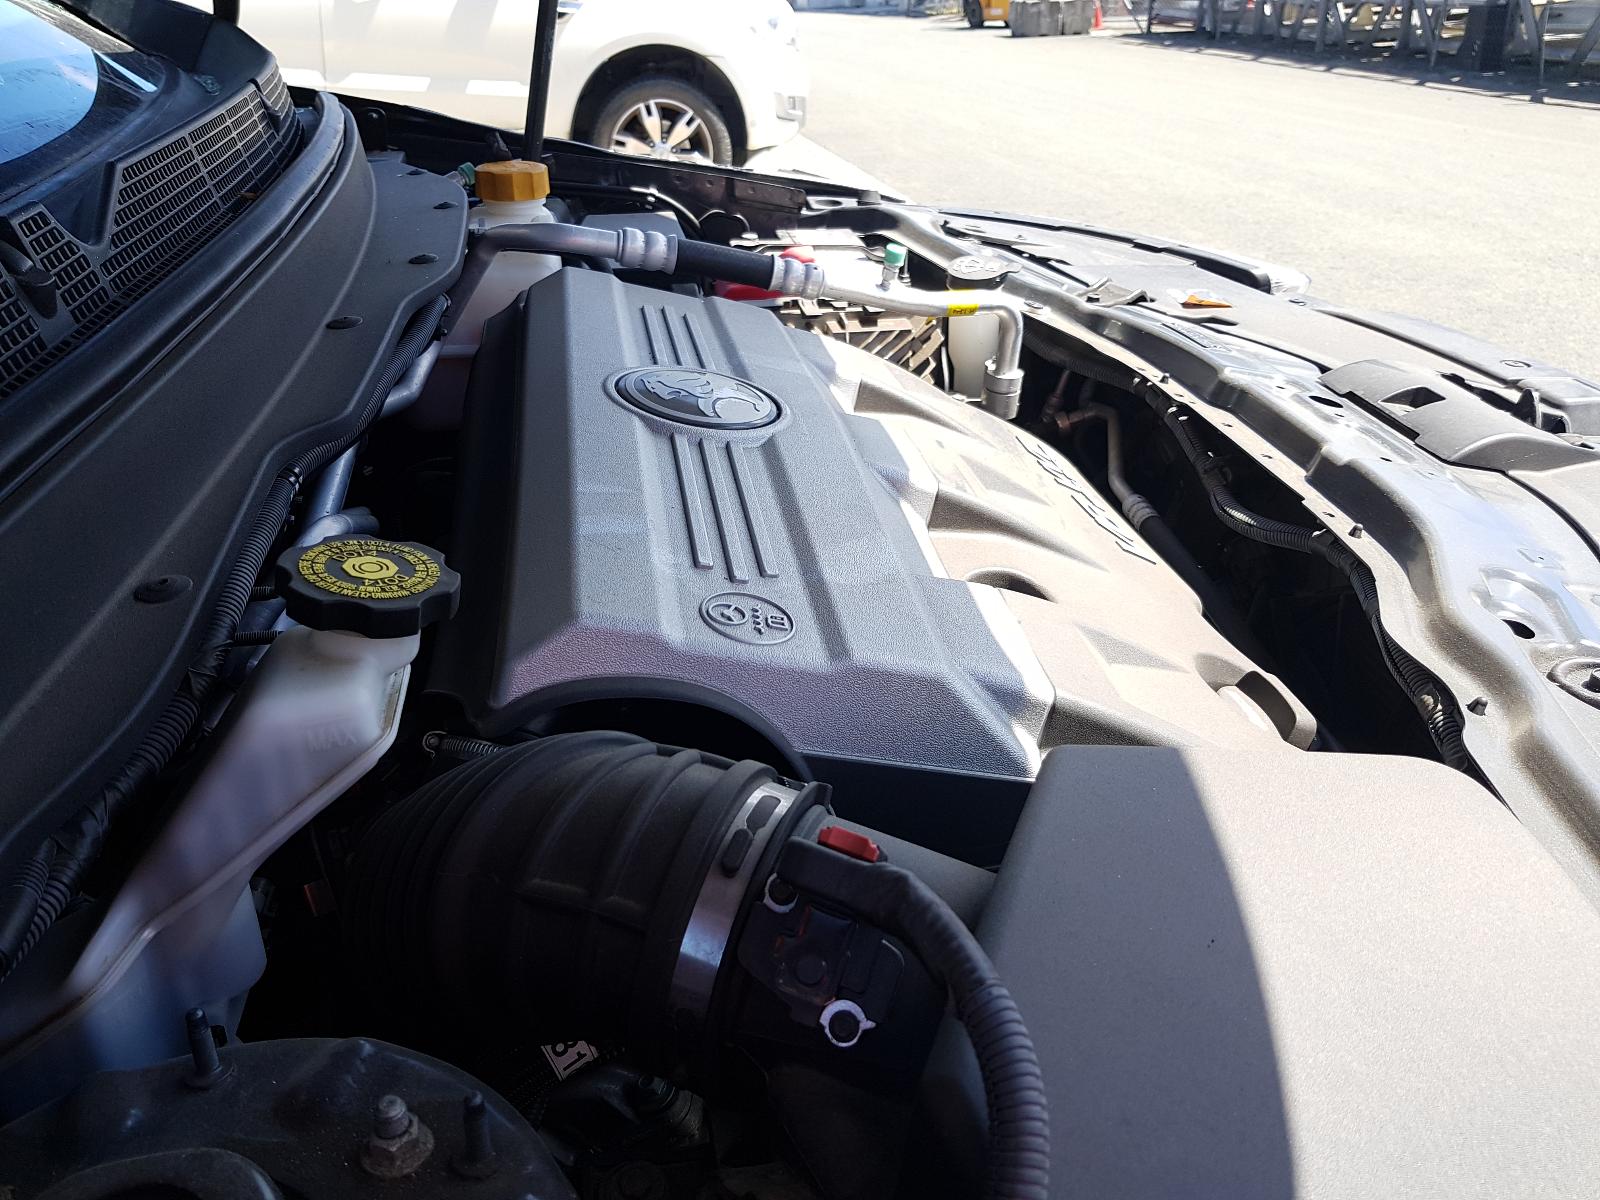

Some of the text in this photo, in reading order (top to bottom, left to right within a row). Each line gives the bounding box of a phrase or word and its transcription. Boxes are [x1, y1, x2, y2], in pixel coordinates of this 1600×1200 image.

[392, 544, 415, 553] FLUID
[315, 580, 343, 594] FILLER
[340, 588, 371, 599] CLEAN
[371, 589, 412, 599] WARNING
[305, 722, 358, 754] MAX
